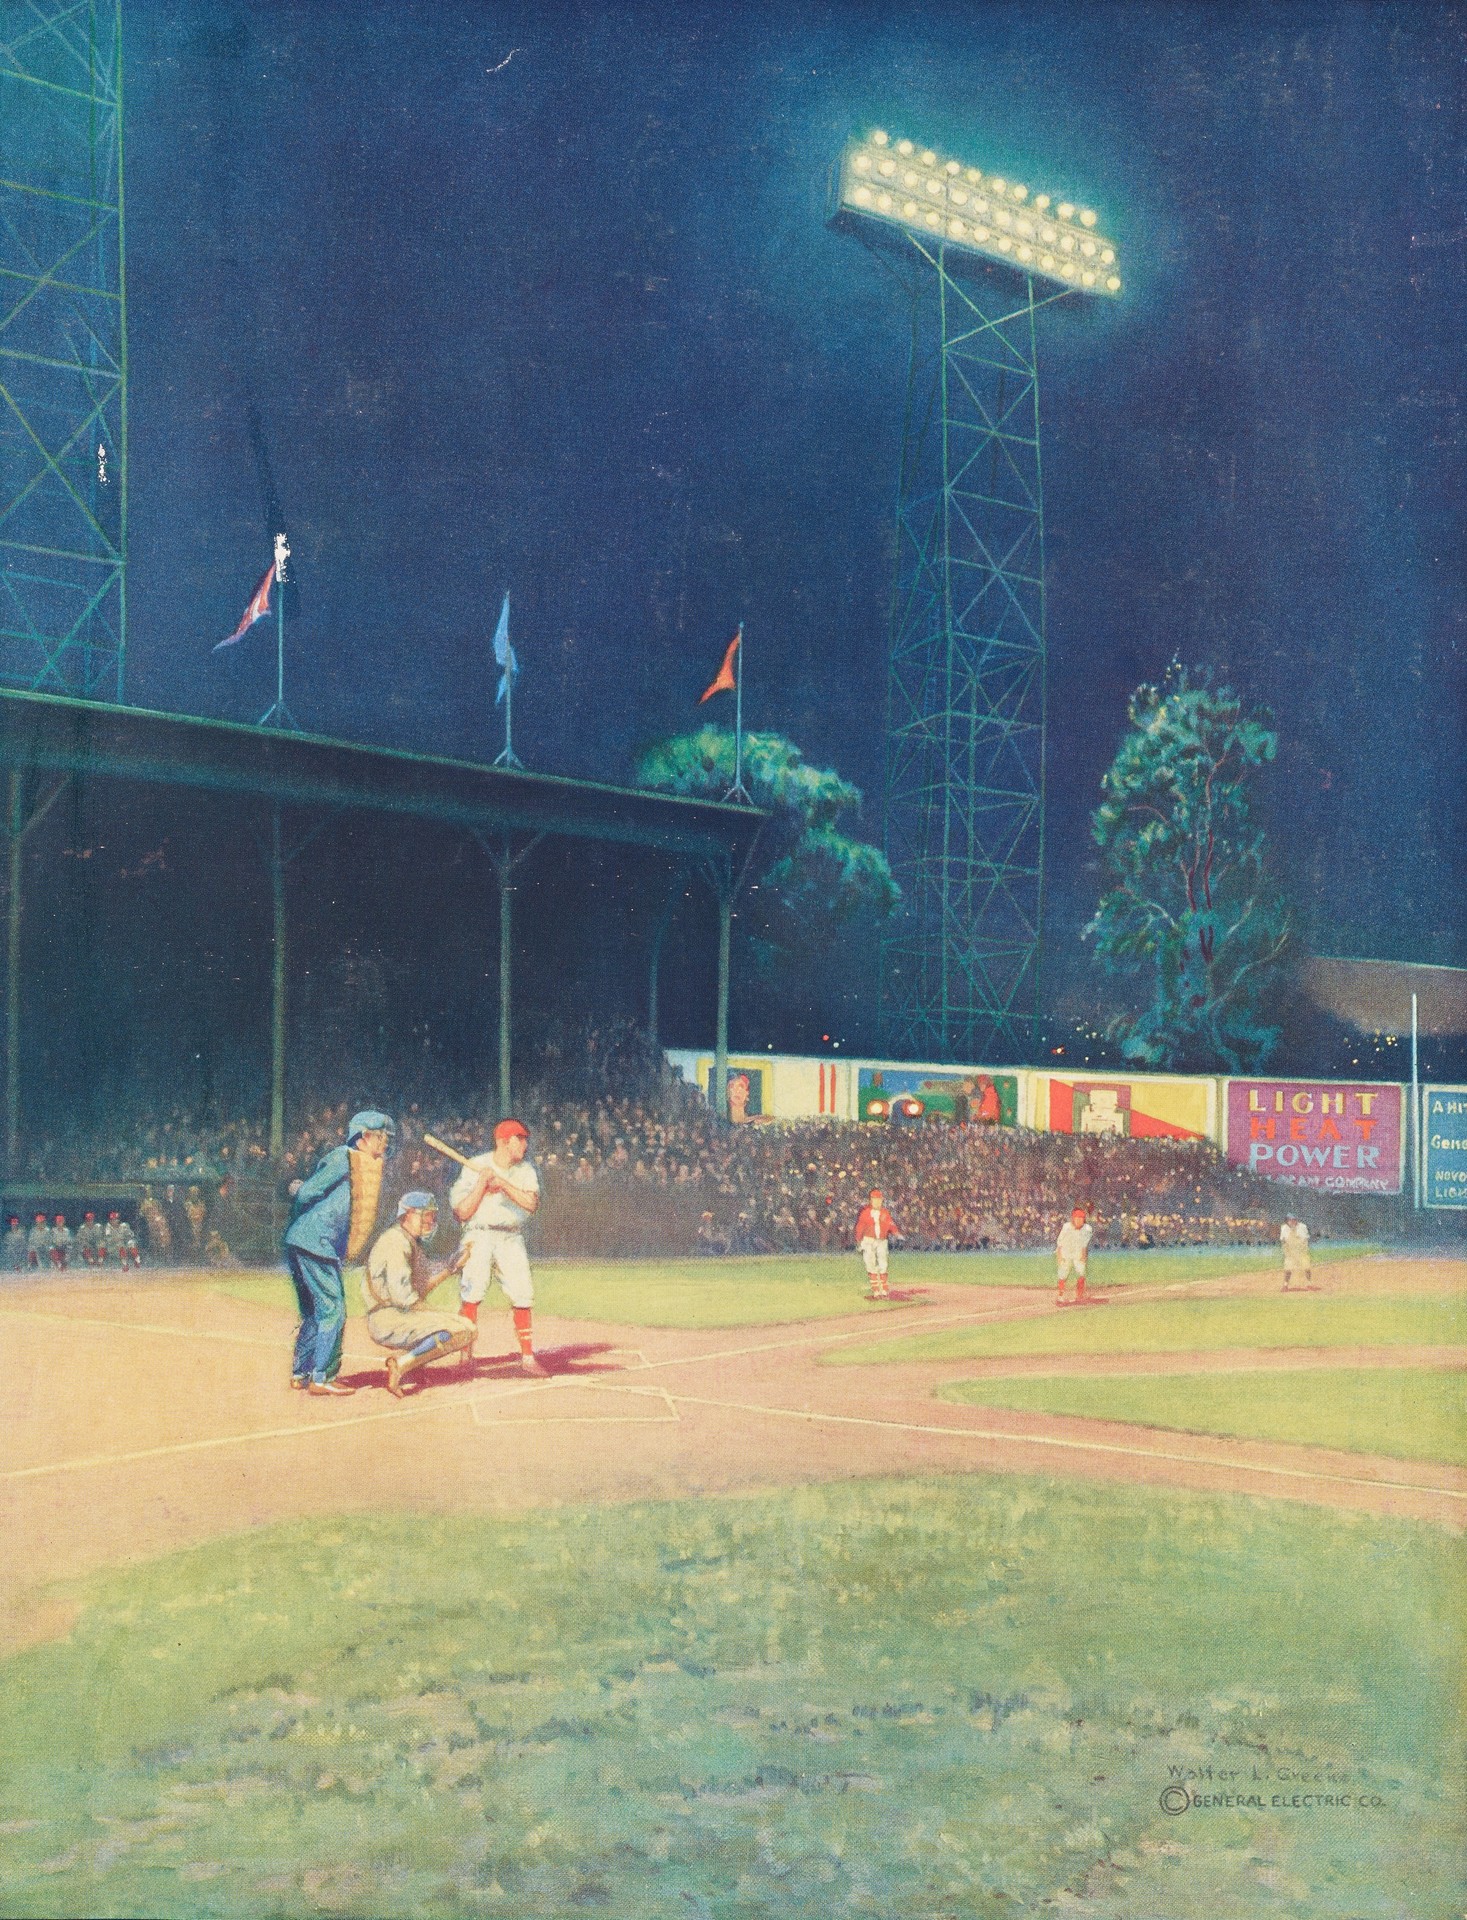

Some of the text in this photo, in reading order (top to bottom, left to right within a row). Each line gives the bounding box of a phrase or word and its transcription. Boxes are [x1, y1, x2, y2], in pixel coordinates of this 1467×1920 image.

[1249, 1089, 1378, 1115] LIGHT
[1432, 1100, 1444, 1114] A
[1250, 1116, 1378, 1141] HEAT
[1249, 1142, 1381, 1173] POWER
[1325, 1175, 1389, 1191] COMPANY
[1167, 1764, 1240, 1782] Walter
[1252, 1764, 1269, 1782] L.
[1193, 1794, 1267, 1808] GENERAL
[1271, 1794, 1351, 1808] ELECTRIC
[1358, 1795, 1387, 1808] CO.
